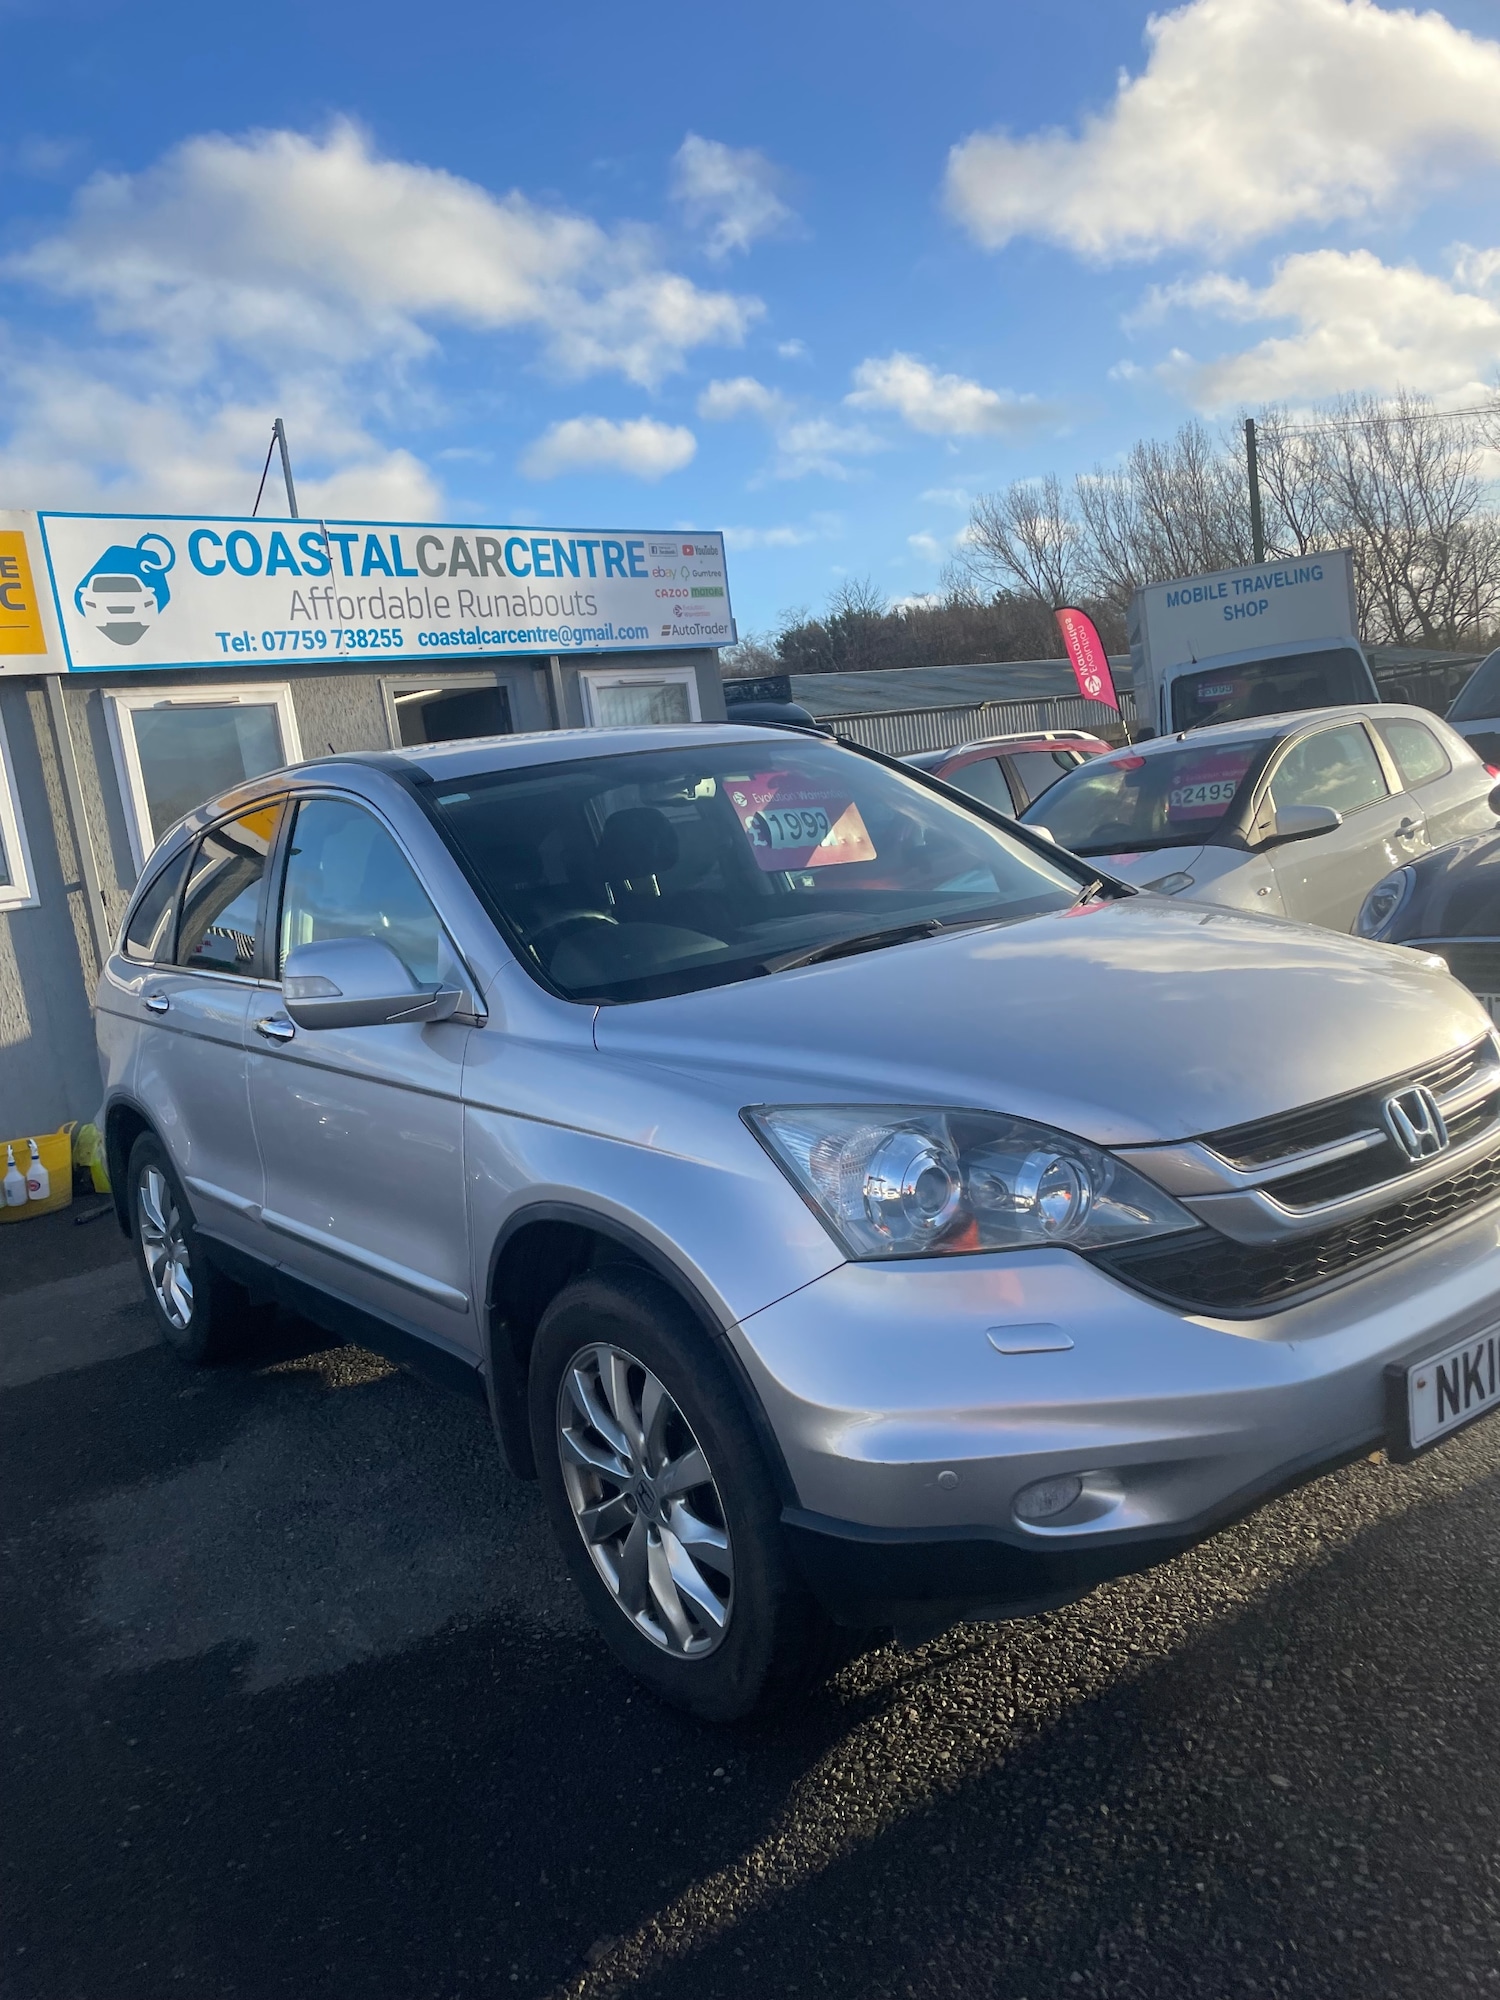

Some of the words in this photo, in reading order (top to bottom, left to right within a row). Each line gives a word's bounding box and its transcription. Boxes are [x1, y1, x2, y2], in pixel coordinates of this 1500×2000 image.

[188, 528, 649, 577] COASTALCARCENTRE
[653, 566, 676, 579] ebay
[693, 569, 721, 577] Gumtree
[1166, 582, 1228, 608] MOBILE
[1232, 565, 1323, 595] TRAVELING
[290, 586, 451, 621] Affordable
[458, 586, 598, 619] Runabouts
[1223, 599, 1269, 621] SHOP
[215, 631, 258, 653] Tel:
[261, 630, 327, 651] 07759
[330, 628, 404, 648] 738255
[418, 622, 649, 647] coastalcarcentre@gmail.com
[672, 622, 728, 636] AutoTrader
[752, 792, 796, 804] Evolution
[1171, 783, 1234, 807] £2495
